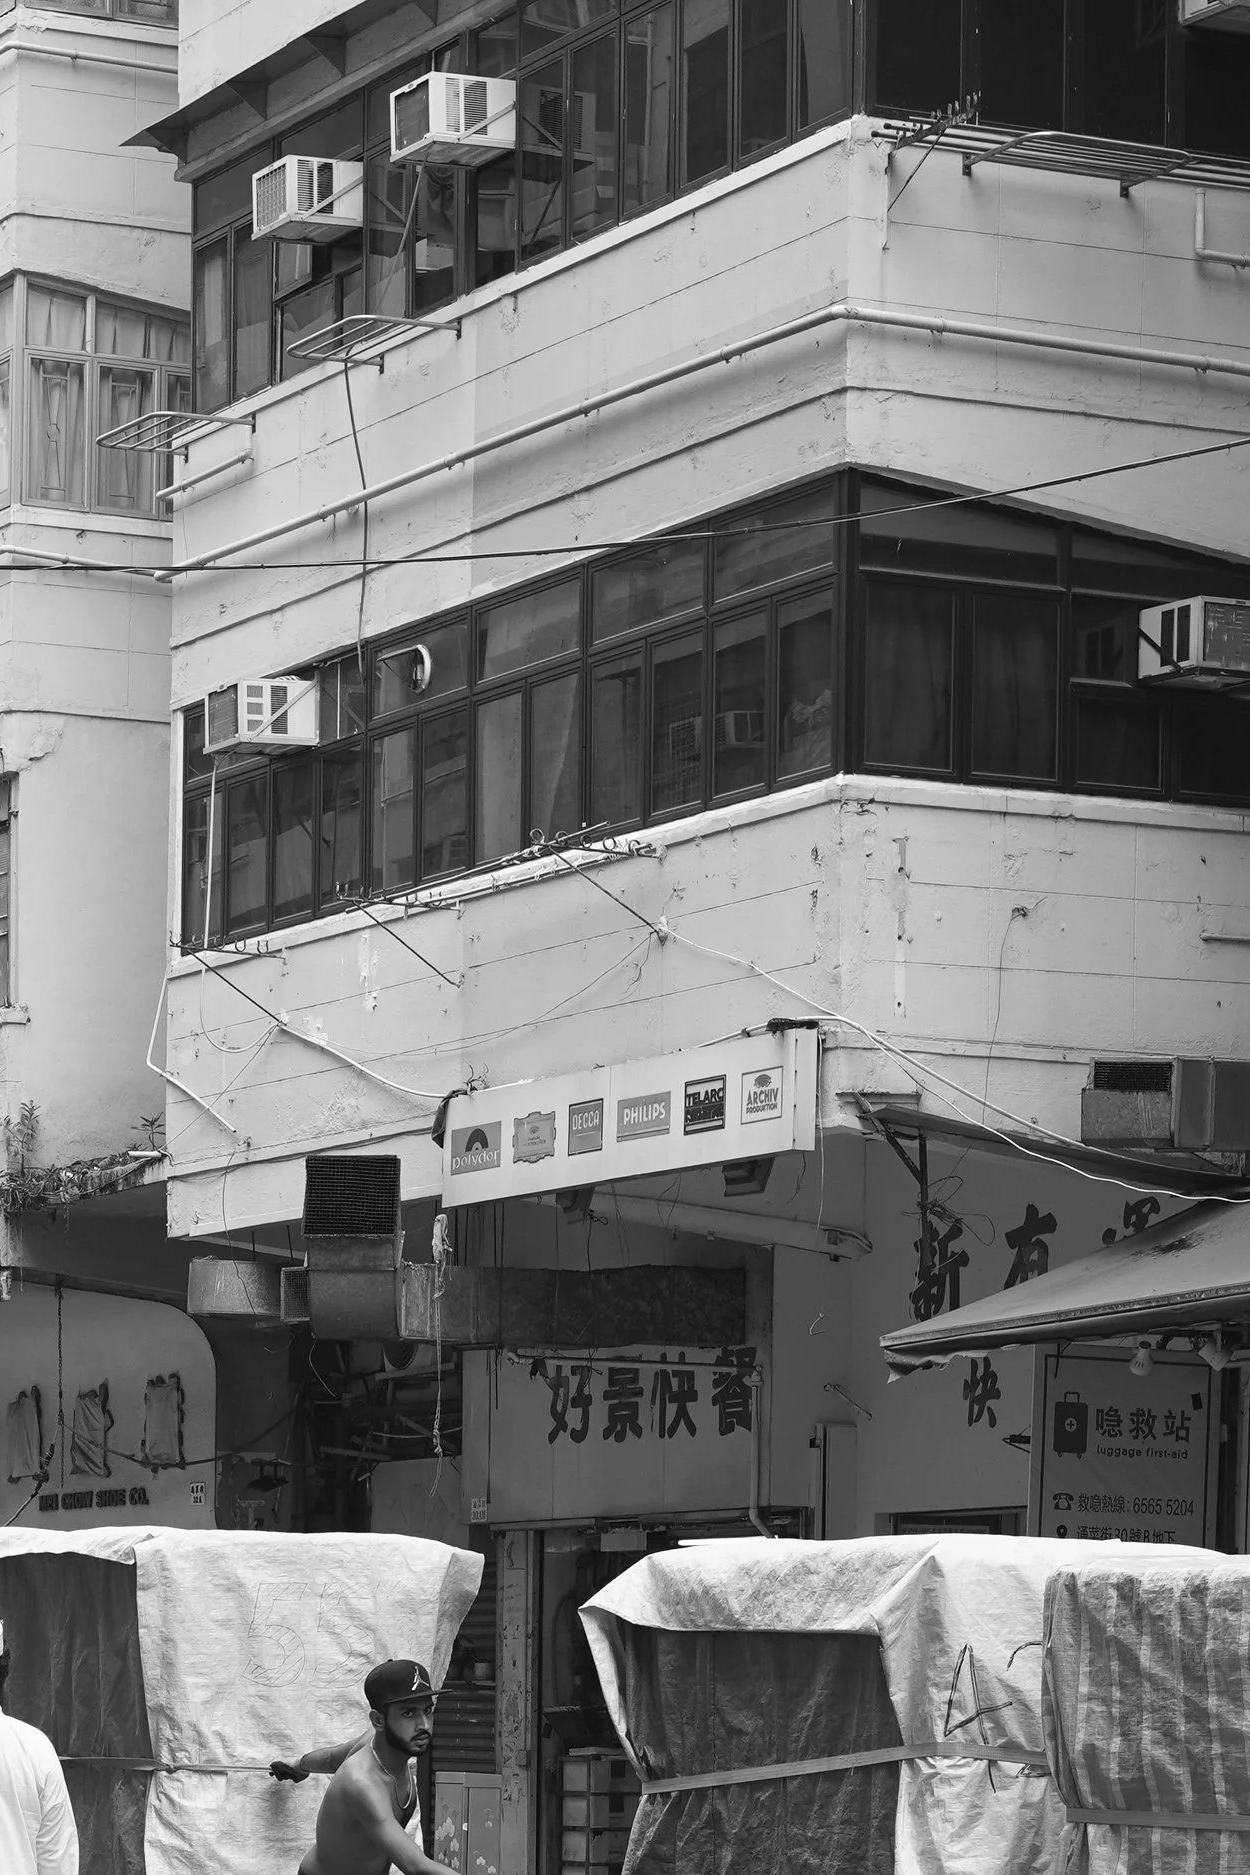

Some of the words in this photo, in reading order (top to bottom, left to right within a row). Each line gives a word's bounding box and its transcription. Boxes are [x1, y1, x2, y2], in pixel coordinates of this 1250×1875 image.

[747, 1087, 780, 1106] ARCHIV
[572, 1110, 600, 1131] DECCA
[623, 1101, 666, 1125] PHILIPS
[452, 1149, 500, 1170] polydor
[548, 1347, 757, 1444] 好景快餐
[962, 1356, 1001, 1428] 快
[1095, 1406, 1191, 1443] 喼救站
[1097, 1444, 1142, 1459] luggage
[1146, 1445, 1188, 1459] first-aid
[61, 1491, 94, 1510] CHOW
[95, 1488, 127, 1508] SHOE
[129, 1487, 149, 1506] CO.
[1133, 1496, 1162, 1515] 6565
[1165, 1498, 1194, 1516] 5204
